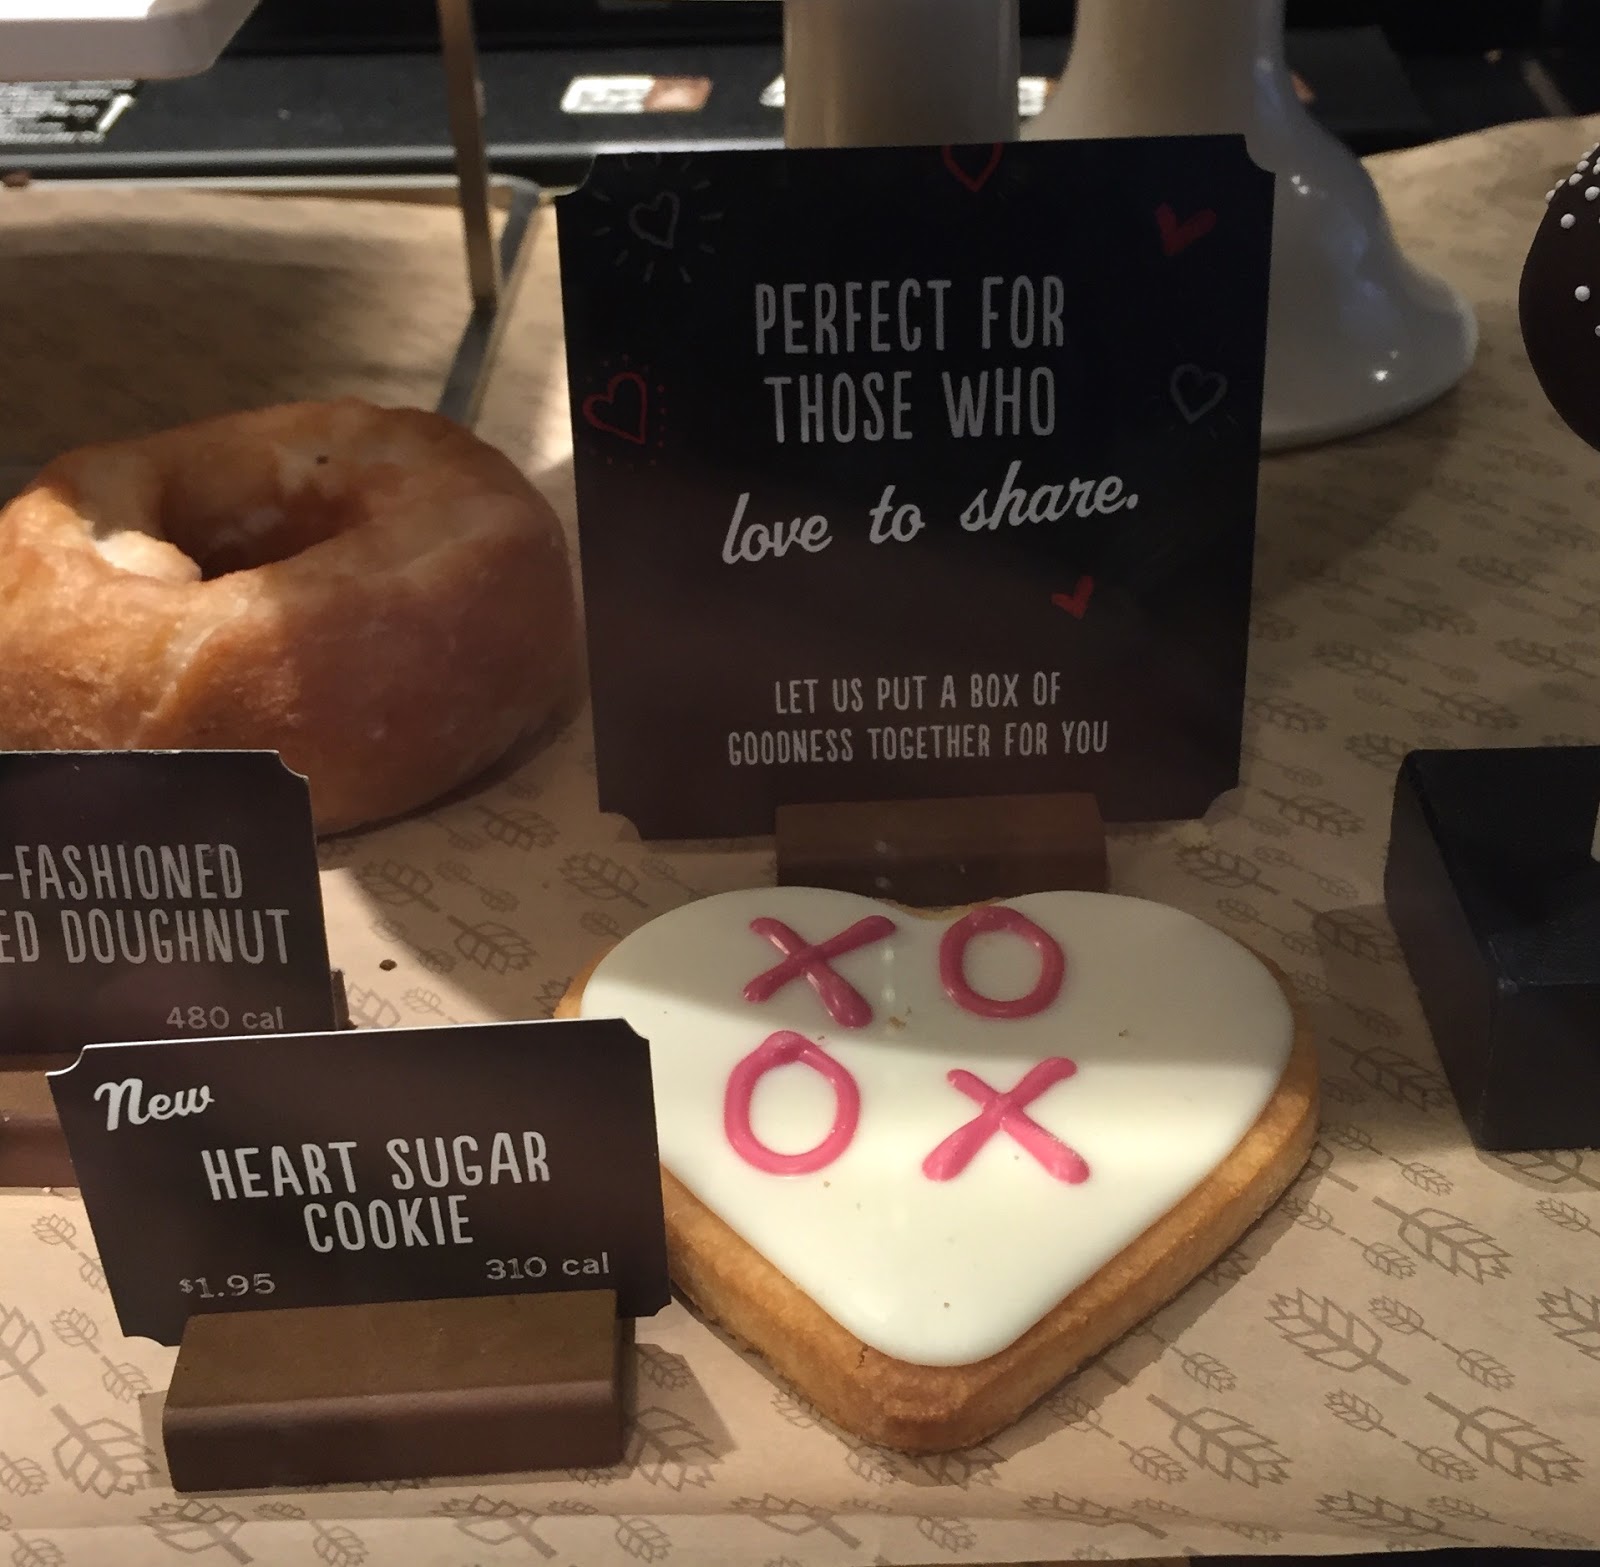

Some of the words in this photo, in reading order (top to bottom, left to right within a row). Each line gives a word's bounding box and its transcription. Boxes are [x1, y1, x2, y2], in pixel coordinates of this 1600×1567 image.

[754, 279, 952, 356] PERFECT
[981, 275, 1065, 349] FOR
[763, 370, 913, 444] THOSE
[942, 366, 1057, 437] WHO
[721, 492, 834, 565] love
[868, 484, 926, 544] to
[960, 460, 1140, 534] share.
[774, 679, 818, 714] LET
[831, 677, 864, 712] US
[876, 676, 928, 711] PUT
[939, 675, 957, 708] A
[970, 673, 1020, 707] BOX
[1032, 671, 1062, 706] OF
[727, 728, 855, 767] GOODNESS
[867, 724, 991, 761] TOGETHER
[1004, 722, 1048, 757] FOR
[1061, 720, 1109, 754] YOU
[61, 908, 290, 964] DOUGHNUT
[165, 1006, 231, 1031] 480
[241, 1005, 285, 1031] cal
[93, 1077, 215, 1132] New
[200, 1142, 358, 1201] HEART
[385, 1130, 551, 1191] SUGAR
[302, 1194, 474, 1254] COOKIE
[179, 1272, 277, 1300] $1.95
[485, 1257, 548, 1281] 310
[562, 1252, 610, 1277] cal
